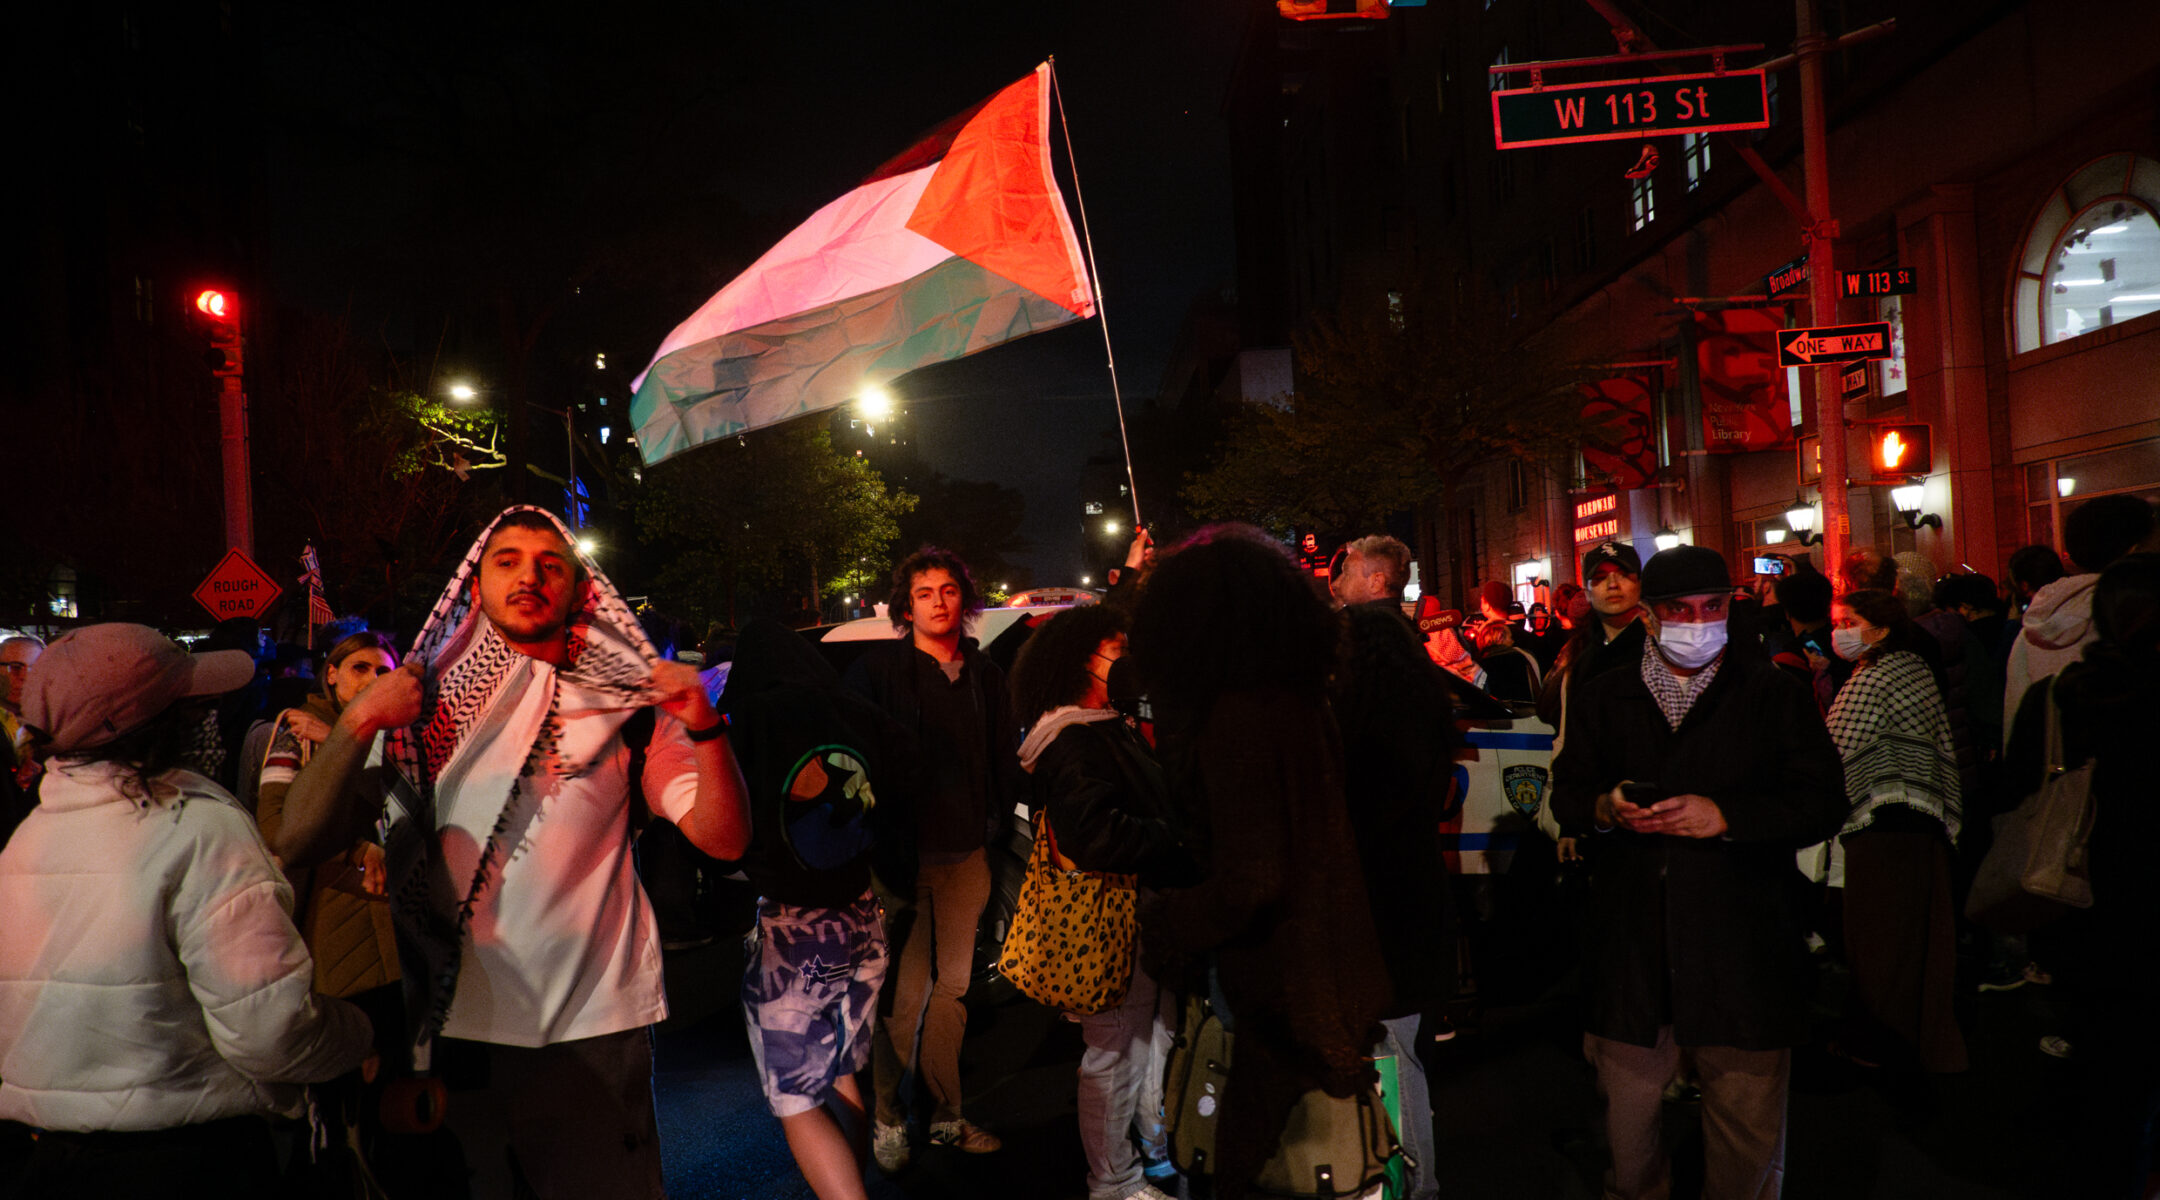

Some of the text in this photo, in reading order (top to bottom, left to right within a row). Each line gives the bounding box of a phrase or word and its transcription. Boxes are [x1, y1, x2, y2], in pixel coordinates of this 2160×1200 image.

[1554, 86, 1710, 129] W 113 St
[1847, 270, 1910, 295] W 113 St
[1796, 335, 1875, 354] ONE WAY
[1712, 428, 1752, 443] Library
[214, 579, 258, 593] ROUGH
[219, 599, 255, 612] ROAD
